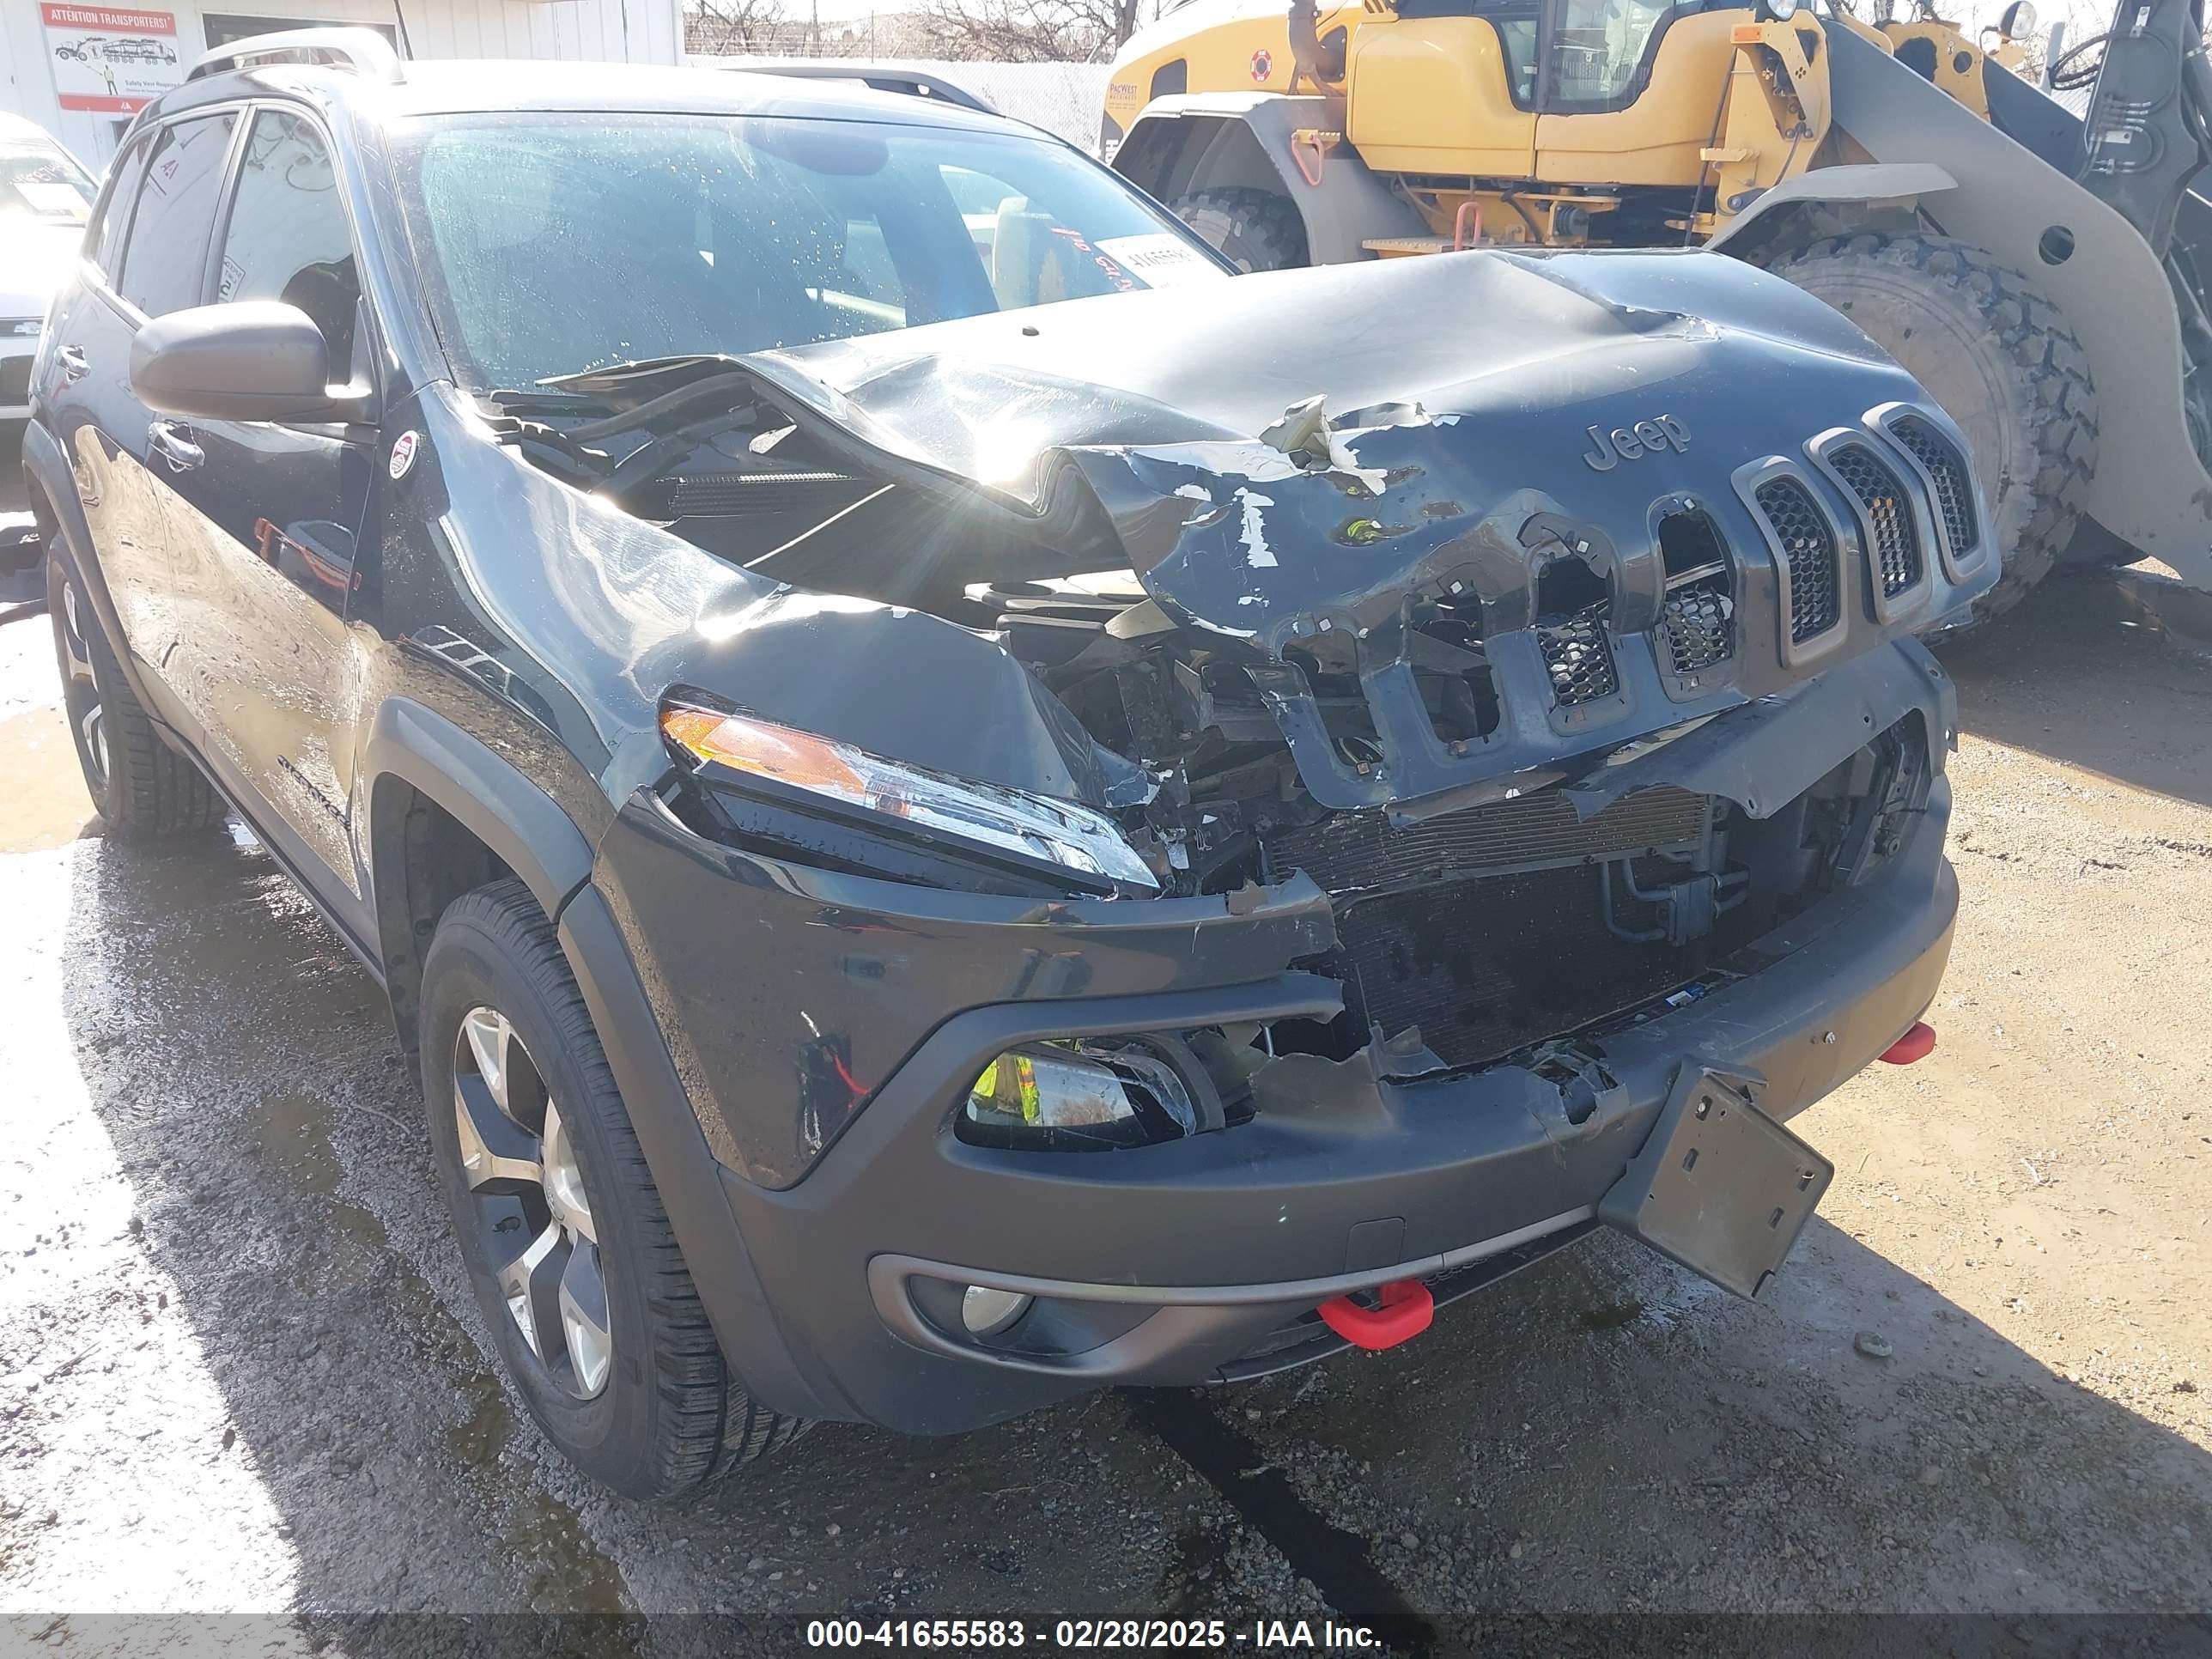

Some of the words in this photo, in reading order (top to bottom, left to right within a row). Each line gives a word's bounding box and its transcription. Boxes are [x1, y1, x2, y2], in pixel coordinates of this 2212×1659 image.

[52, 9, 97, 23] ATTENTION
[100, 13, 167, 28] TRANSPORTERS!
[1583, 413, 1692, 471] Jeep
